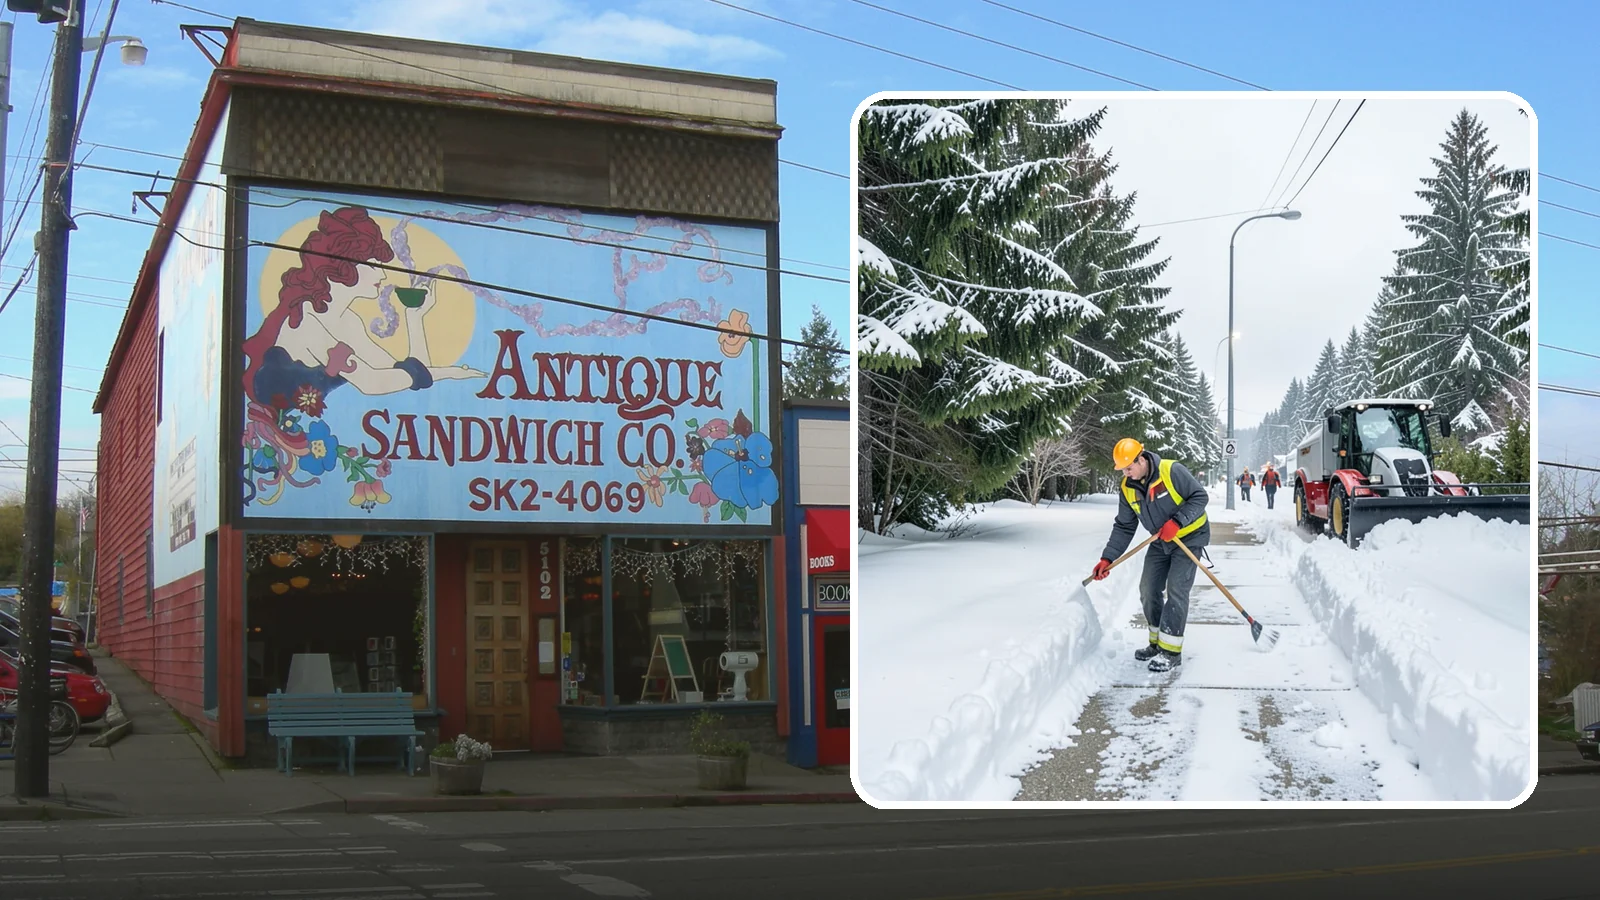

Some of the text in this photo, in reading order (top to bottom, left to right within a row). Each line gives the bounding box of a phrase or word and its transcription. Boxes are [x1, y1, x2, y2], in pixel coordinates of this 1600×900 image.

[475, 328, 724, 421] ANTIQUE
[361, 408, 685, 468] SANDWICH CO.
[468, 477, 645, 512] SK2-4069
[539, 541, 552, 600] 5102
[809, 555, 835, 569] BOOKS
